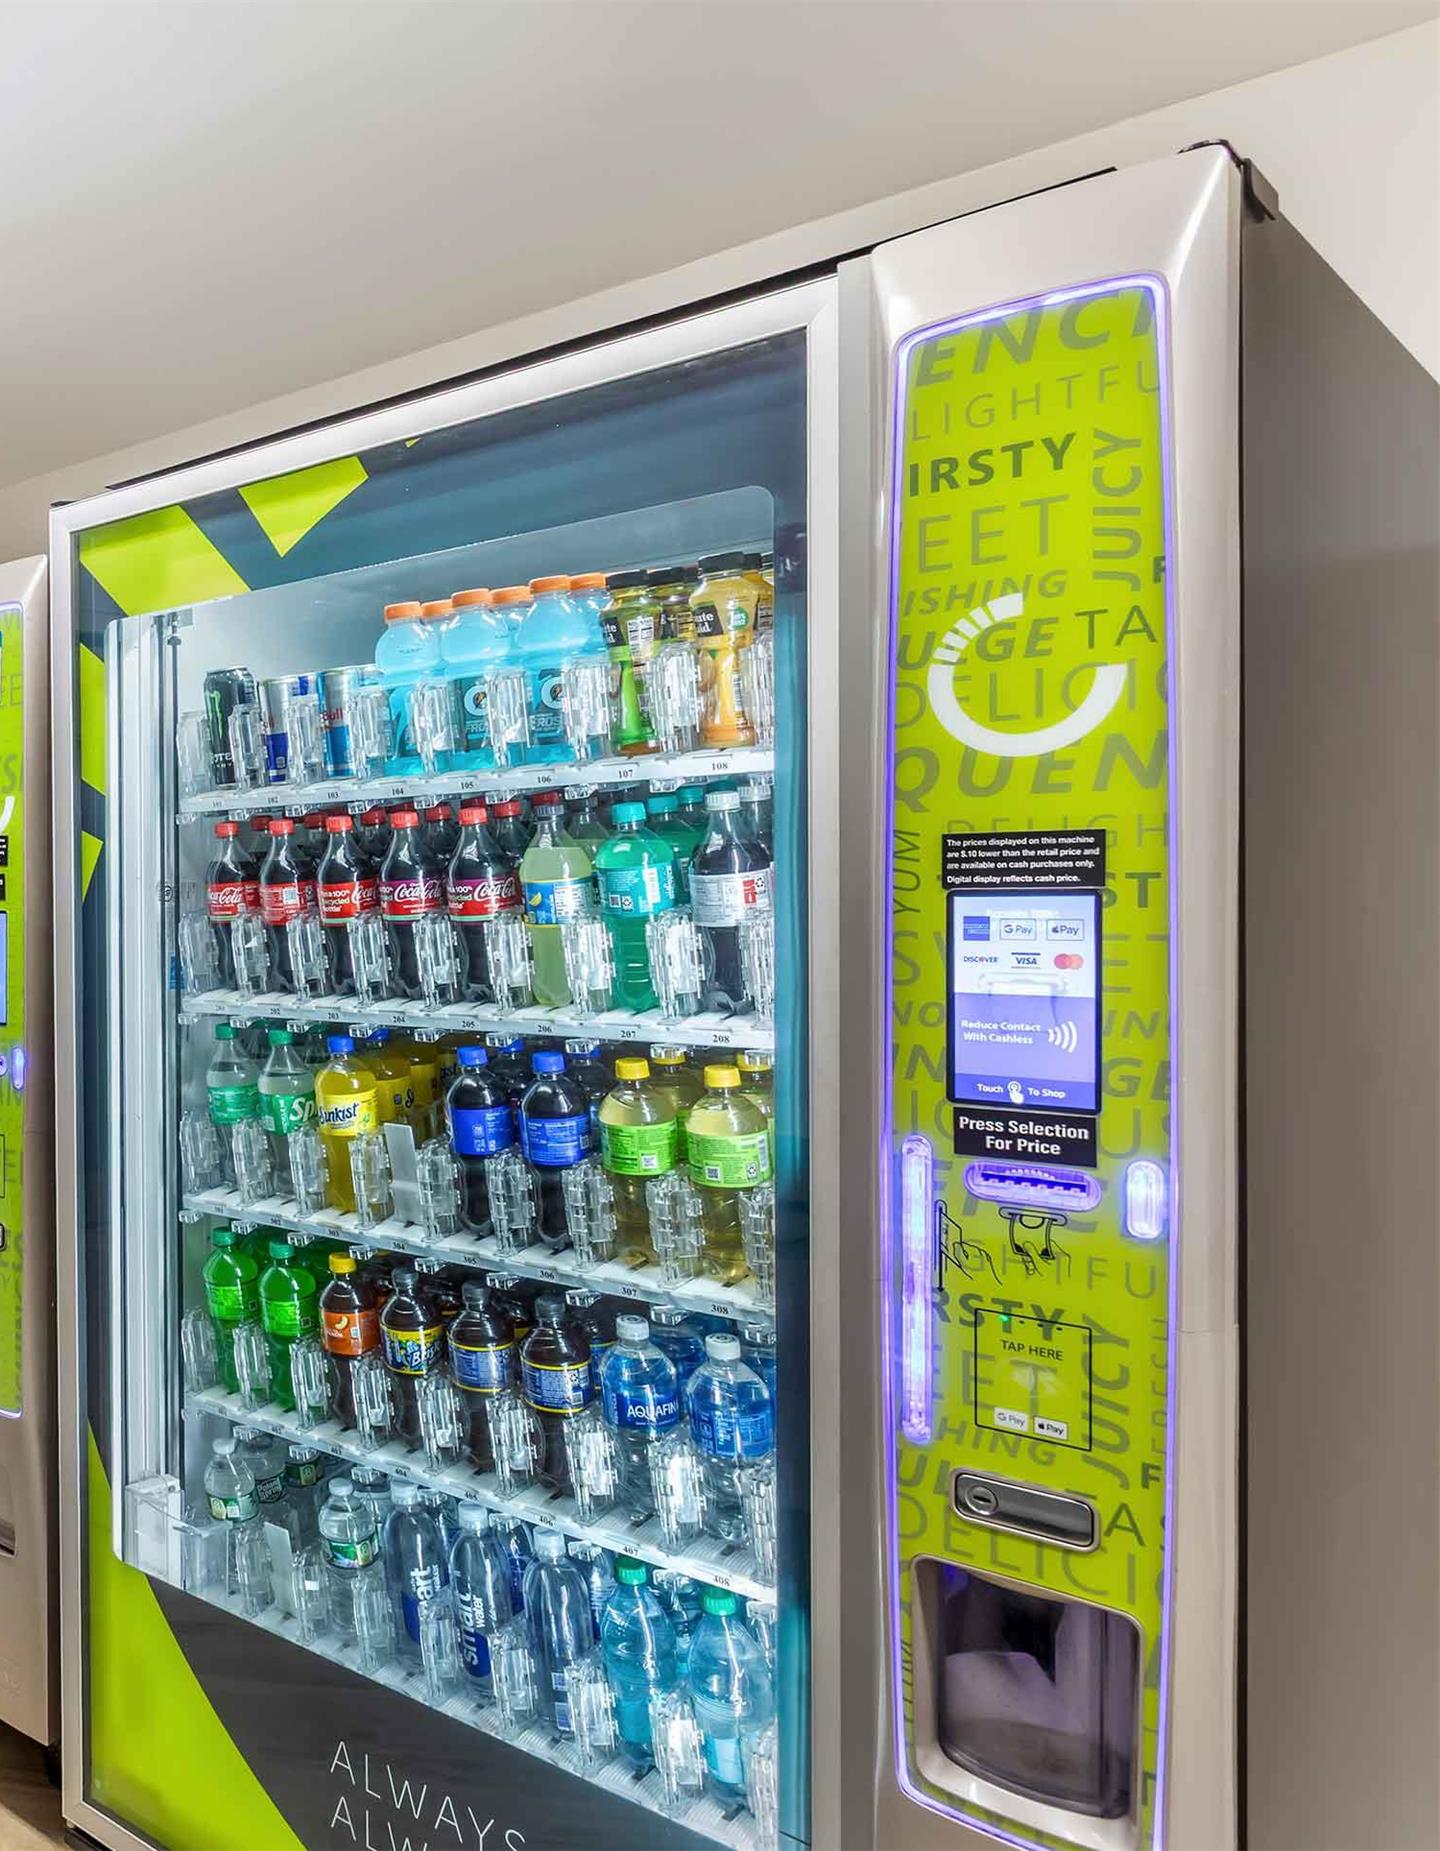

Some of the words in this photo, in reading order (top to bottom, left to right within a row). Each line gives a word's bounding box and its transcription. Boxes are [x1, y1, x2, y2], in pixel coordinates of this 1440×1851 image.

[1092, 427, 1142, 592] JUICY
[711, 762, 728, 771] 108
[618, 769, 633, 778] 107
[537, 775, 552, 784] 106
[460, 782, 474, 790] 105
[327, 791, 339, 799] 103
[391, 788, 404, 796] 104
[947, 839, 961, 847] The
[963, 838, 987, 847] prices
[989, 837, 1027, 847] displayed
[1041, 836, 1057, 844] this
[1058, 836, 1095, 844] machine
[1002, 849, 1021, 857] than
[1037, 848, 1058, 856] retail
[1060, 848, 1081, 857] price
[1083, 847, 1100, 855] and
[961, 861, 995, 869] available
[1009, 860, 1028, 868] cash
[1030, 860, 1073, 869] purchases
[1075, 860, 1095, 869] only.
[947, 875, 972, 884] Digital
[973, 875, 1001, 884] display
[1003, 875, 1033, 883] reflects
[1034, 874, 1055, 882] cash
[1056, 874, 1080, 883] price.
[1015, 924, 1033, 935] Pay
[1060, 924, 1079, 936] Pay
[963, 955, 998, 964] DISCOVER
[1016, 957, 1038, 965] VISA
[392, 1016, 405, 1024] 204
[462, 1020, 475, 1029] 205
[537, 1024, 552, 1033] 206
[961, 1020, 1000, 1030] Reduce
[1000, 1022, 1041, 1032] Contact
[621, 1029, 636, 1038] 207
[712, 1034, 730, 1043] 208
[963, 1032, 988, 1042] With
[989, 1034, 1034, 1045] Cashless
[977, 1083, 1004, 1094] Touch
[1028, 1087, 1040, 1097] To
[1045, 1088, 1066, 1099] Shop
[959, 1117, 1004, 1132] Press
[1008, 1120, 1090, 1140] Selection
[986, 1135, 1014, 1150] For
[1017, 1138, 1061, 1155] Price
[463, 1255, 477, 1265] 305
[539, 1270, 555, 1280] 306
[621, 1288, 637, 1298] 307
[711, 1304, 729, 1315] 308
[1001, 1340, 1025, 1353] TAP
[1029, 1344, 1063, 1361] HERE
[472, 1594, 485, 1629] water
